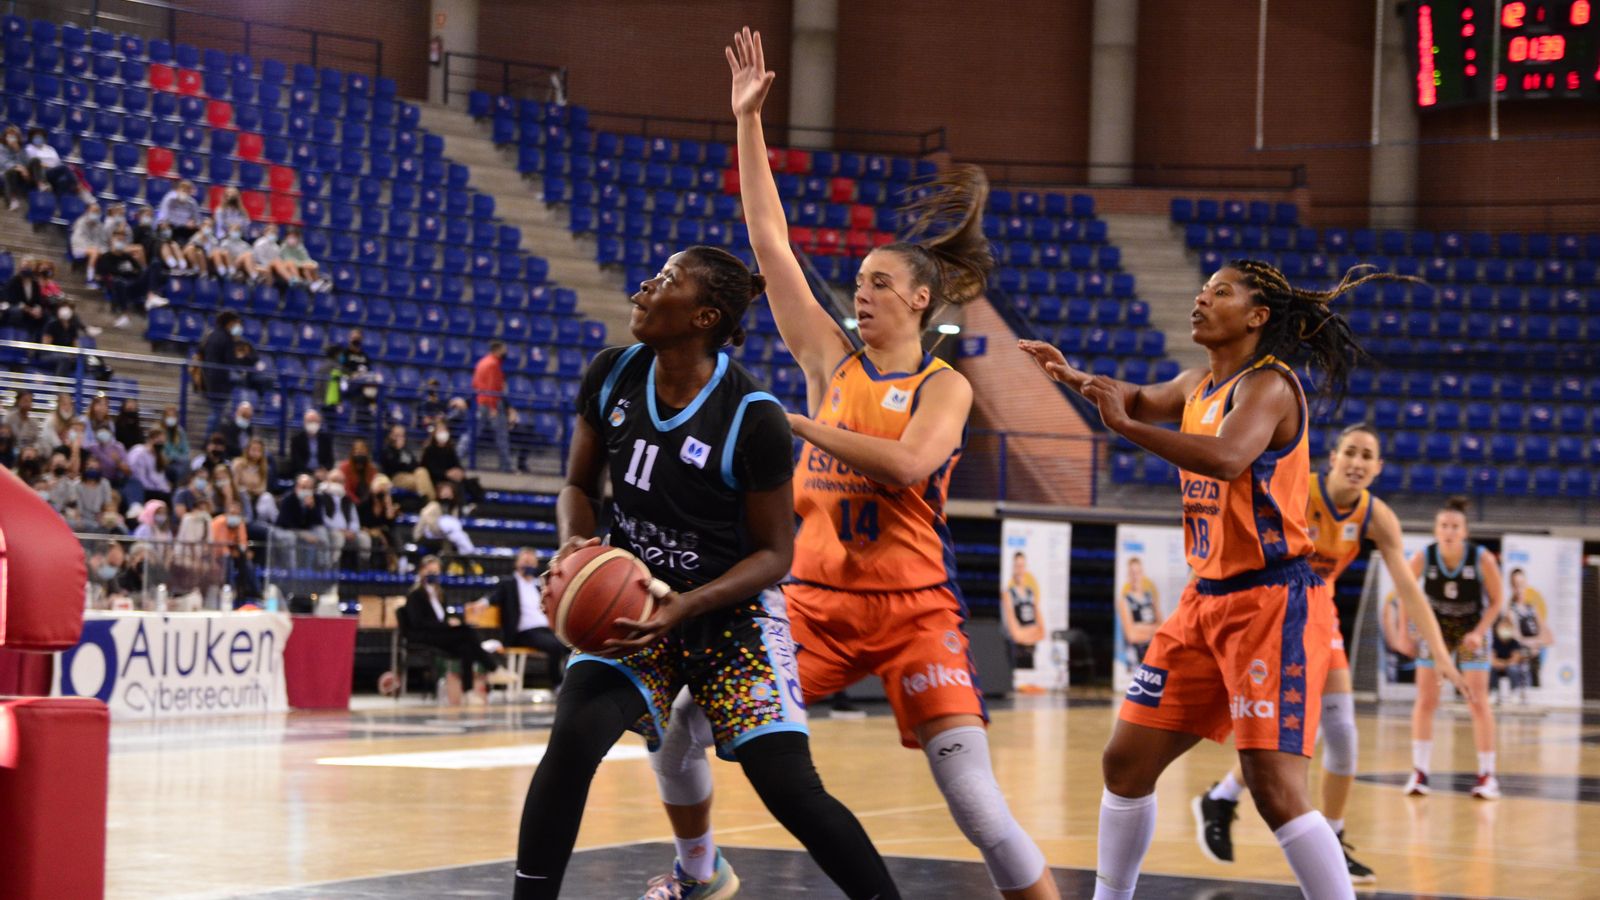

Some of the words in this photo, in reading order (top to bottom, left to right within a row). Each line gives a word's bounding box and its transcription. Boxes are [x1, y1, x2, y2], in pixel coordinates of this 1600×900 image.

[624, 439, 659, 491] 11
[839, 498, 880, 541] 14
[1185, 517, 1210, 559] 18
[1444, 580, 1459, 600] 6
[121, 617, 275, 677] Aiuken
[902, 663, 973, 696] teika
[124, 681, 270, 718] Cybersecurity
[1230, 694, 1275, 720] ika
